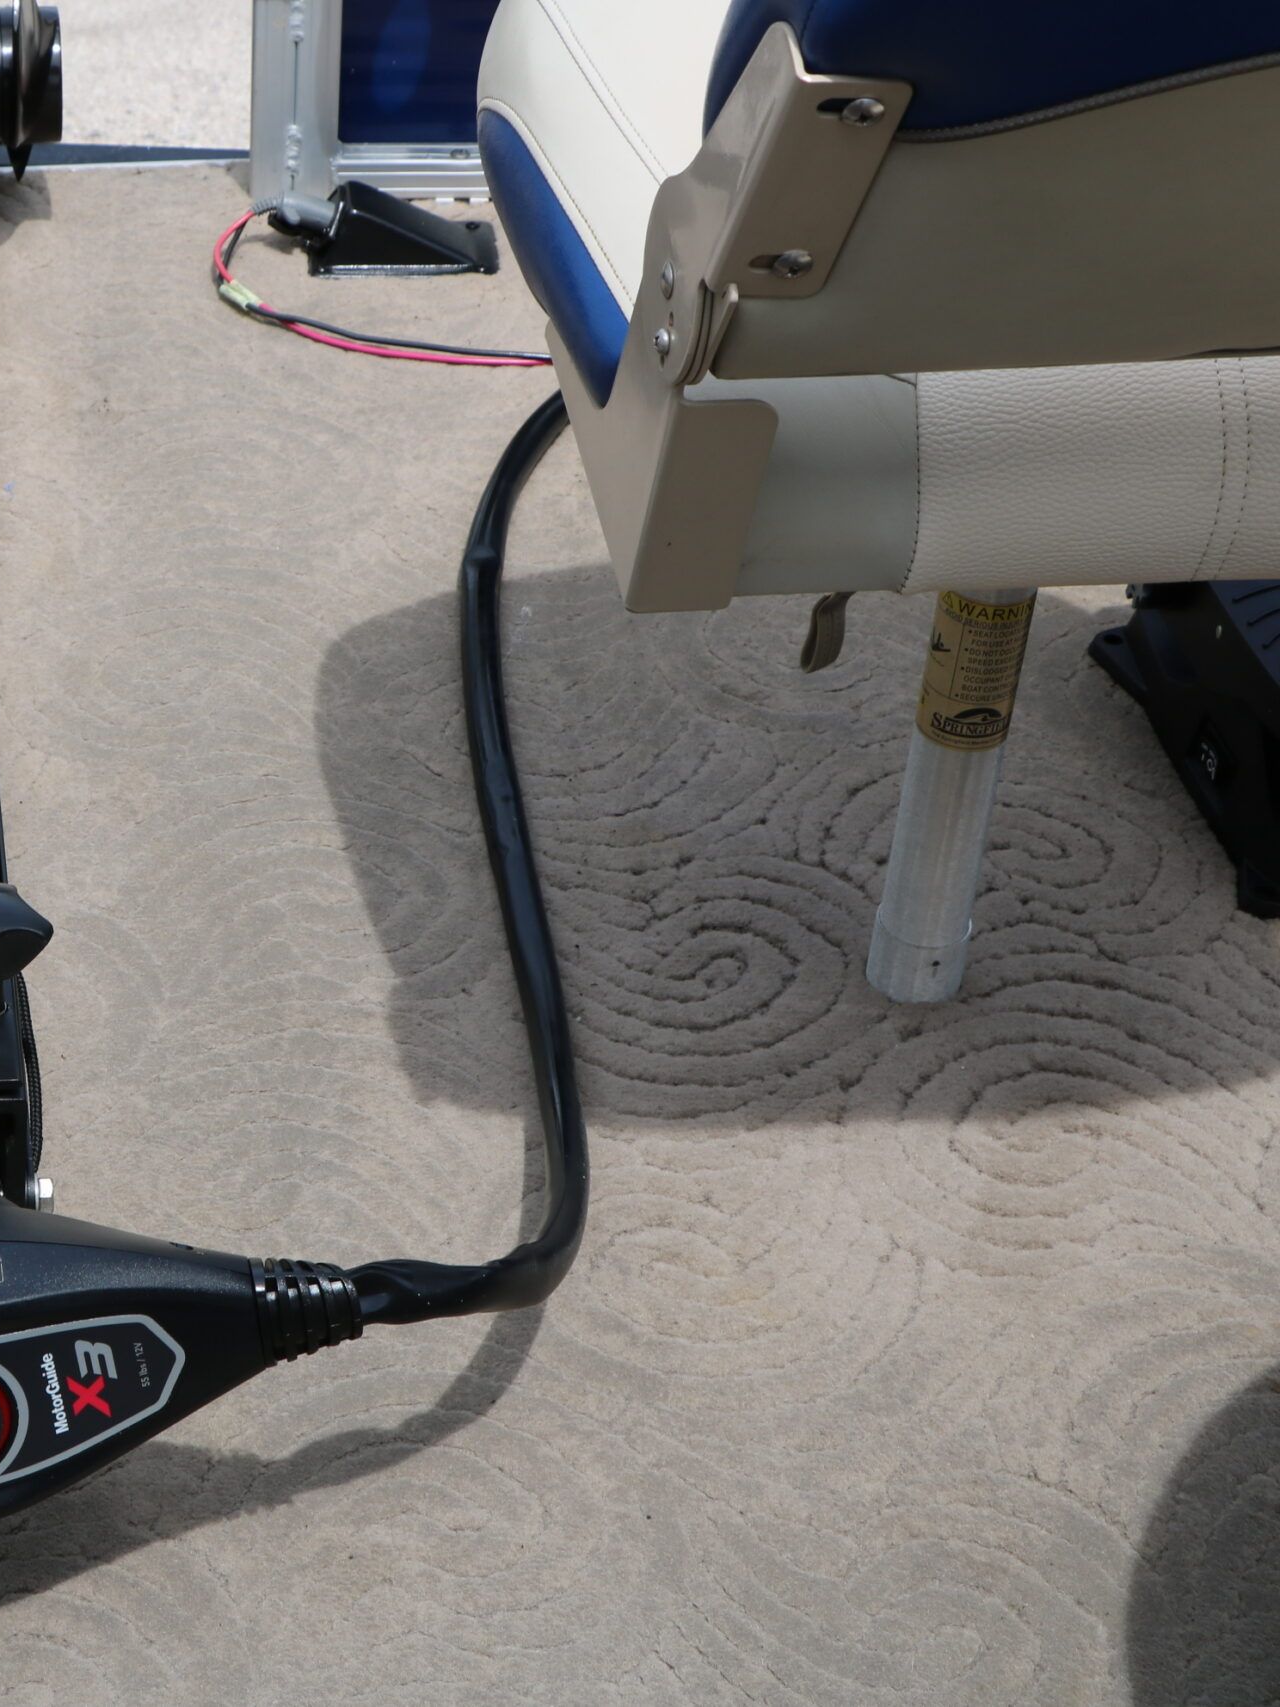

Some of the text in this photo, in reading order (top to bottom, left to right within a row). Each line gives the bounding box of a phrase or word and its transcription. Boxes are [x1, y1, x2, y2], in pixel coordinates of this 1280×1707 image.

[959, 600, 1034, 621] WARNIN
[973, 629, 993, 640] SEAT
[971, 638, 990, 648] FOR
[990, 639, 1005, 648] USE
[969, 648, 982, 657] DO
[982, 648, 998, 658] NOT
[968, 657, 993, 667] SPEED
[964, 674, 1004, 684] OCCUPANT
[962, 683, 982, 693] BOAT
[960, 692, 990, 702] SECURE
[931, 712, 1008, 735] SPRINGFIEL
[132, 1342, 144, 1356] 12V
[138, 1363, 148, 1377] lbs
[65, 1339, 118, 1418] X3
[140, 1376, 150, 1388] 55
[41, 1352, 69, 1434] MotorGuide
